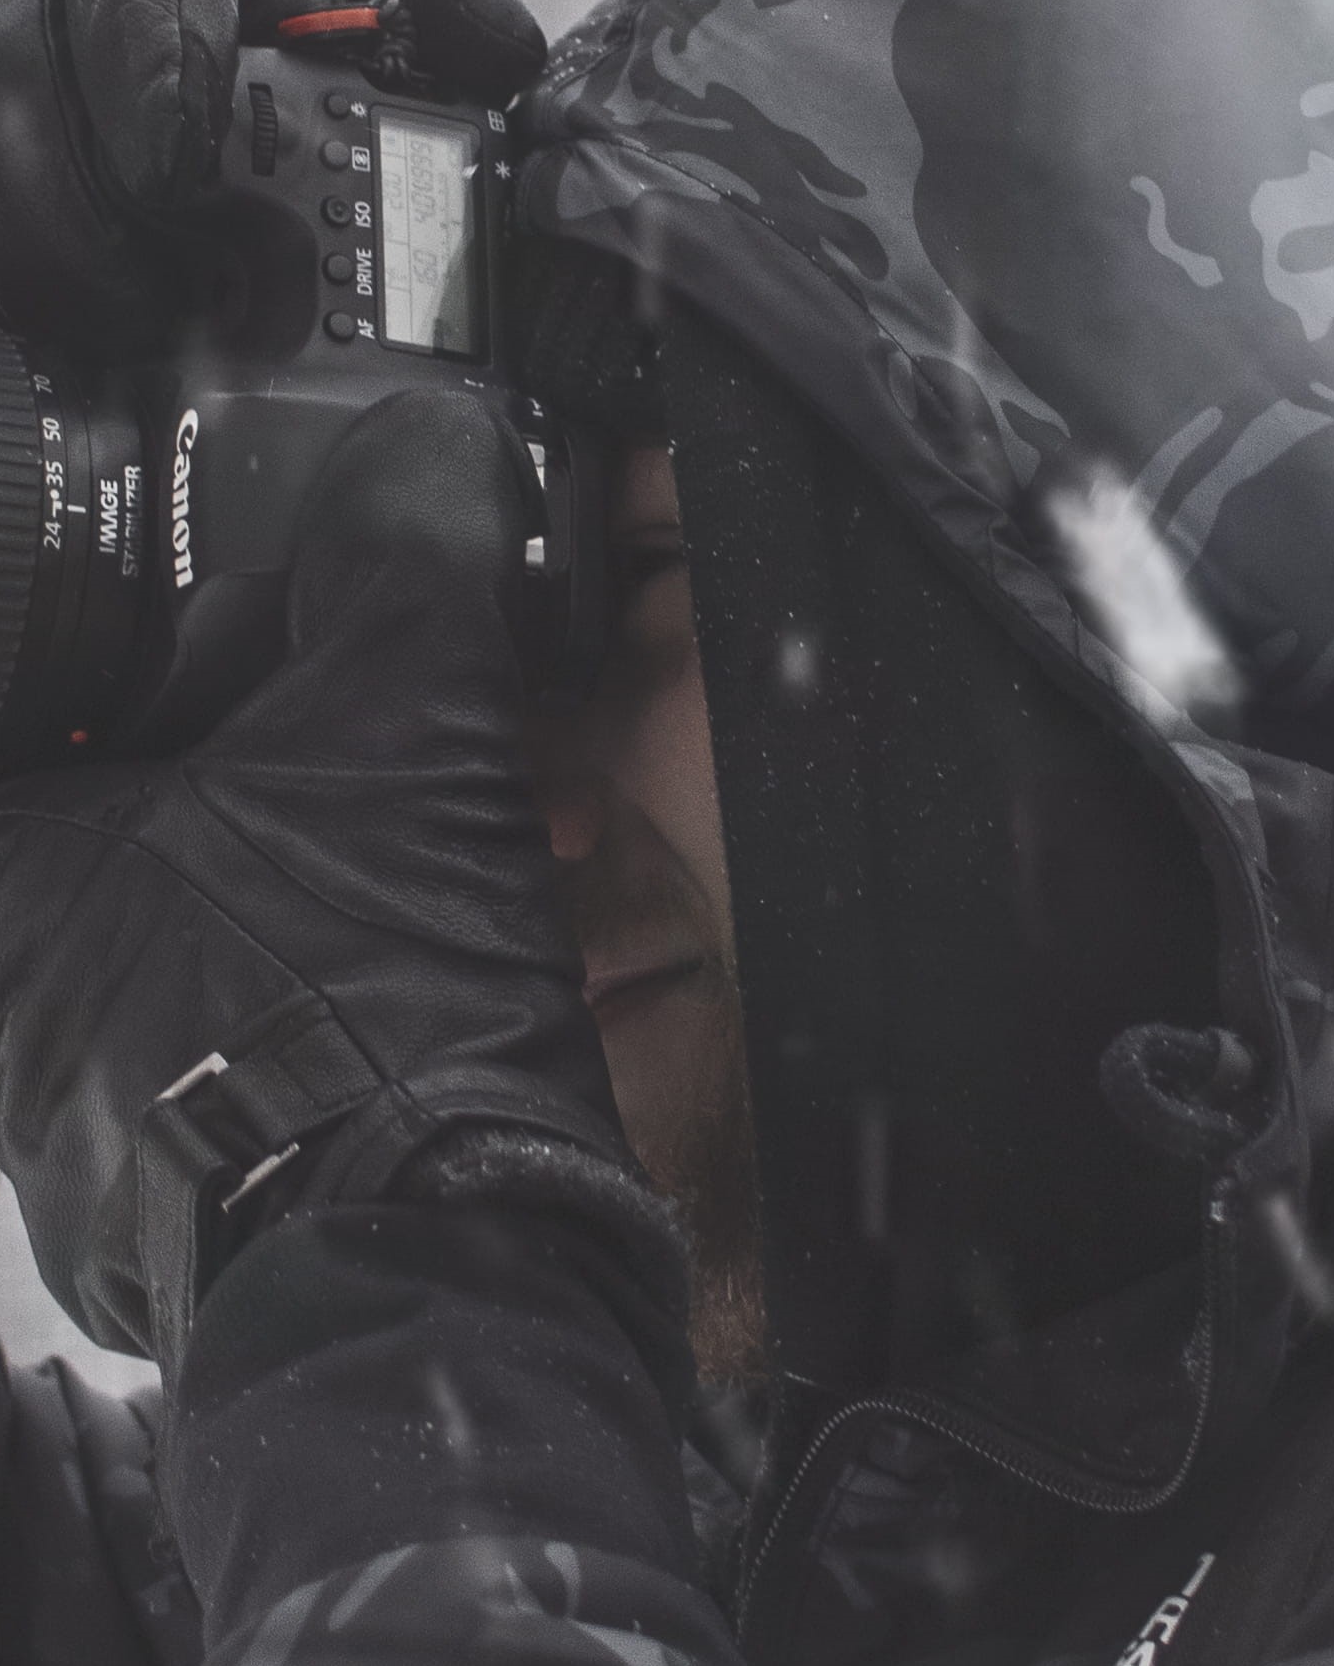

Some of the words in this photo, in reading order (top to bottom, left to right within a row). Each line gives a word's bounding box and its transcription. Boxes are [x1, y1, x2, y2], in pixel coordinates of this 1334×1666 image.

[355, 201, 372, 228] ISO
[356, 247, 373, 296] DRIVE
[358, 317, 376, 340] AF
[33, 374, 52, 394] 70
[42, 417, 61, 442] 50
[46, 460, 63, 488] 35
[172, 408, 199, 589] Canon
[99, 478, 119, 554] IMAGE
[44, 521, 62, 550] 24
